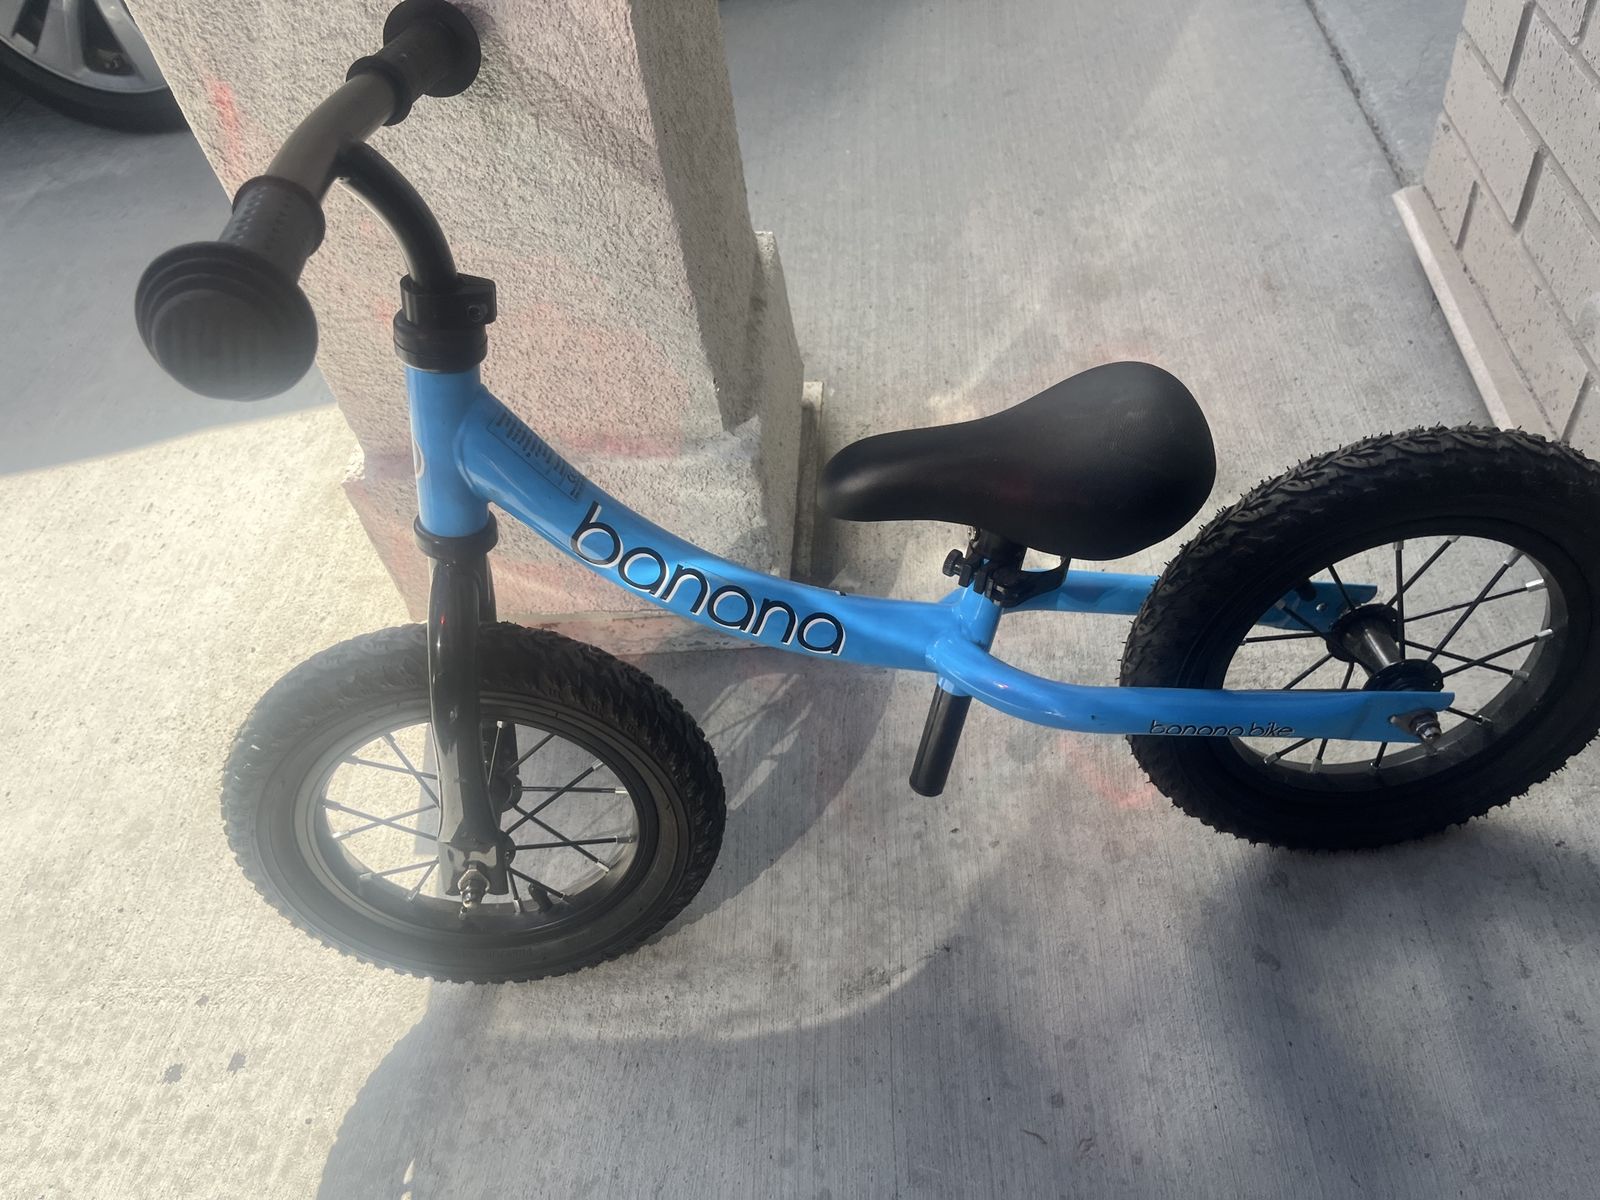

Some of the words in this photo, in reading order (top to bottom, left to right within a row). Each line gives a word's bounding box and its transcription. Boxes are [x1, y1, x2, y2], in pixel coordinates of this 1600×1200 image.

[571, 501, 846, 656] banana
[1150, 720, 1245, 736] banana
[1249, 722, 1295, 736] bike
